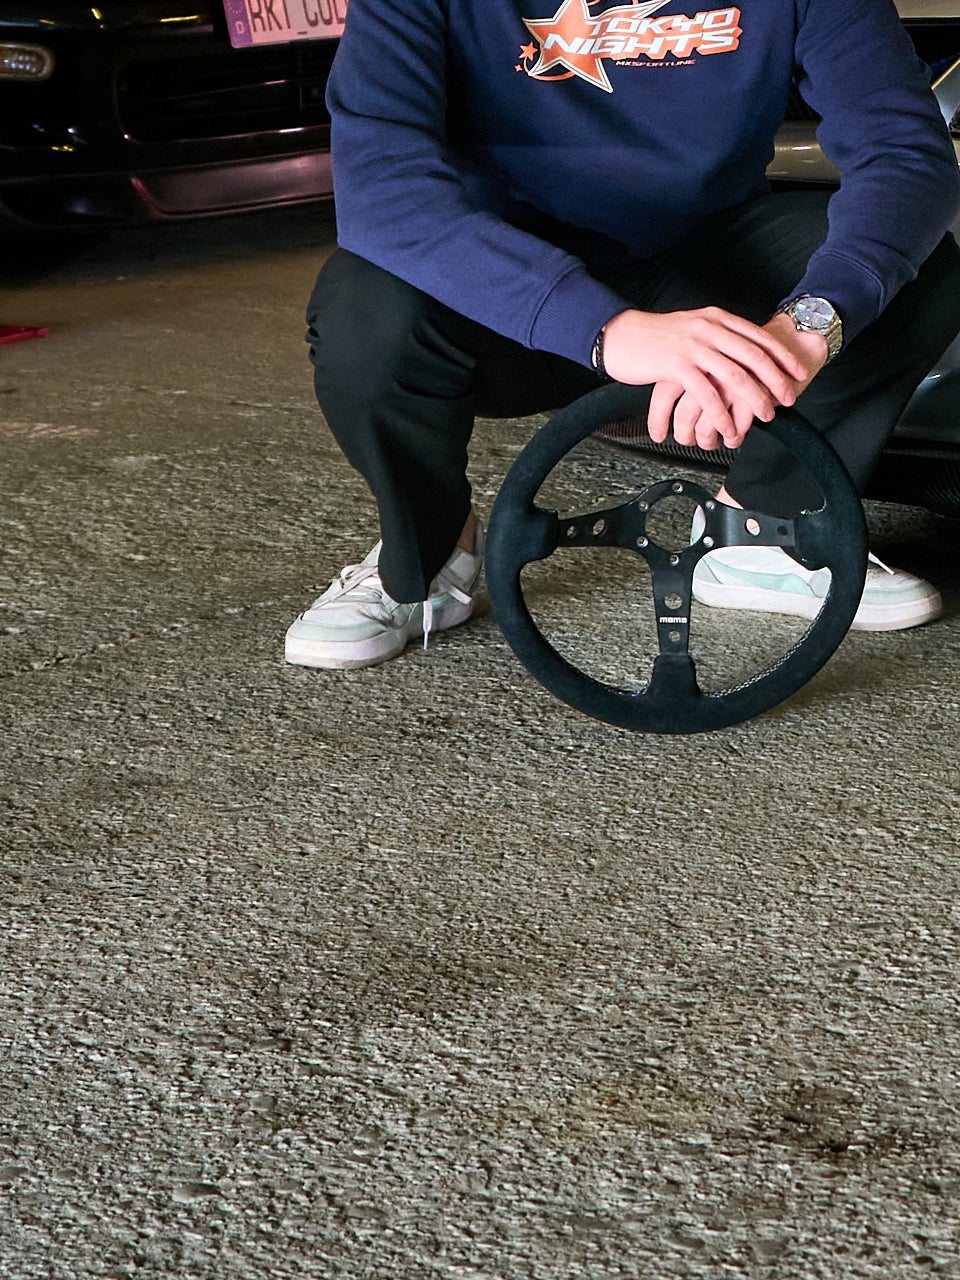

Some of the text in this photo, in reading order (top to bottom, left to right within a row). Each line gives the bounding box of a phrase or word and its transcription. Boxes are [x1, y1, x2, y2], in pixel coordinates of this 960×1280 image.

[590, 7, 737, 36] TOKYO
[543, 28, 737, 56] NIGHTS
[659, 616, 688, 624] momo
